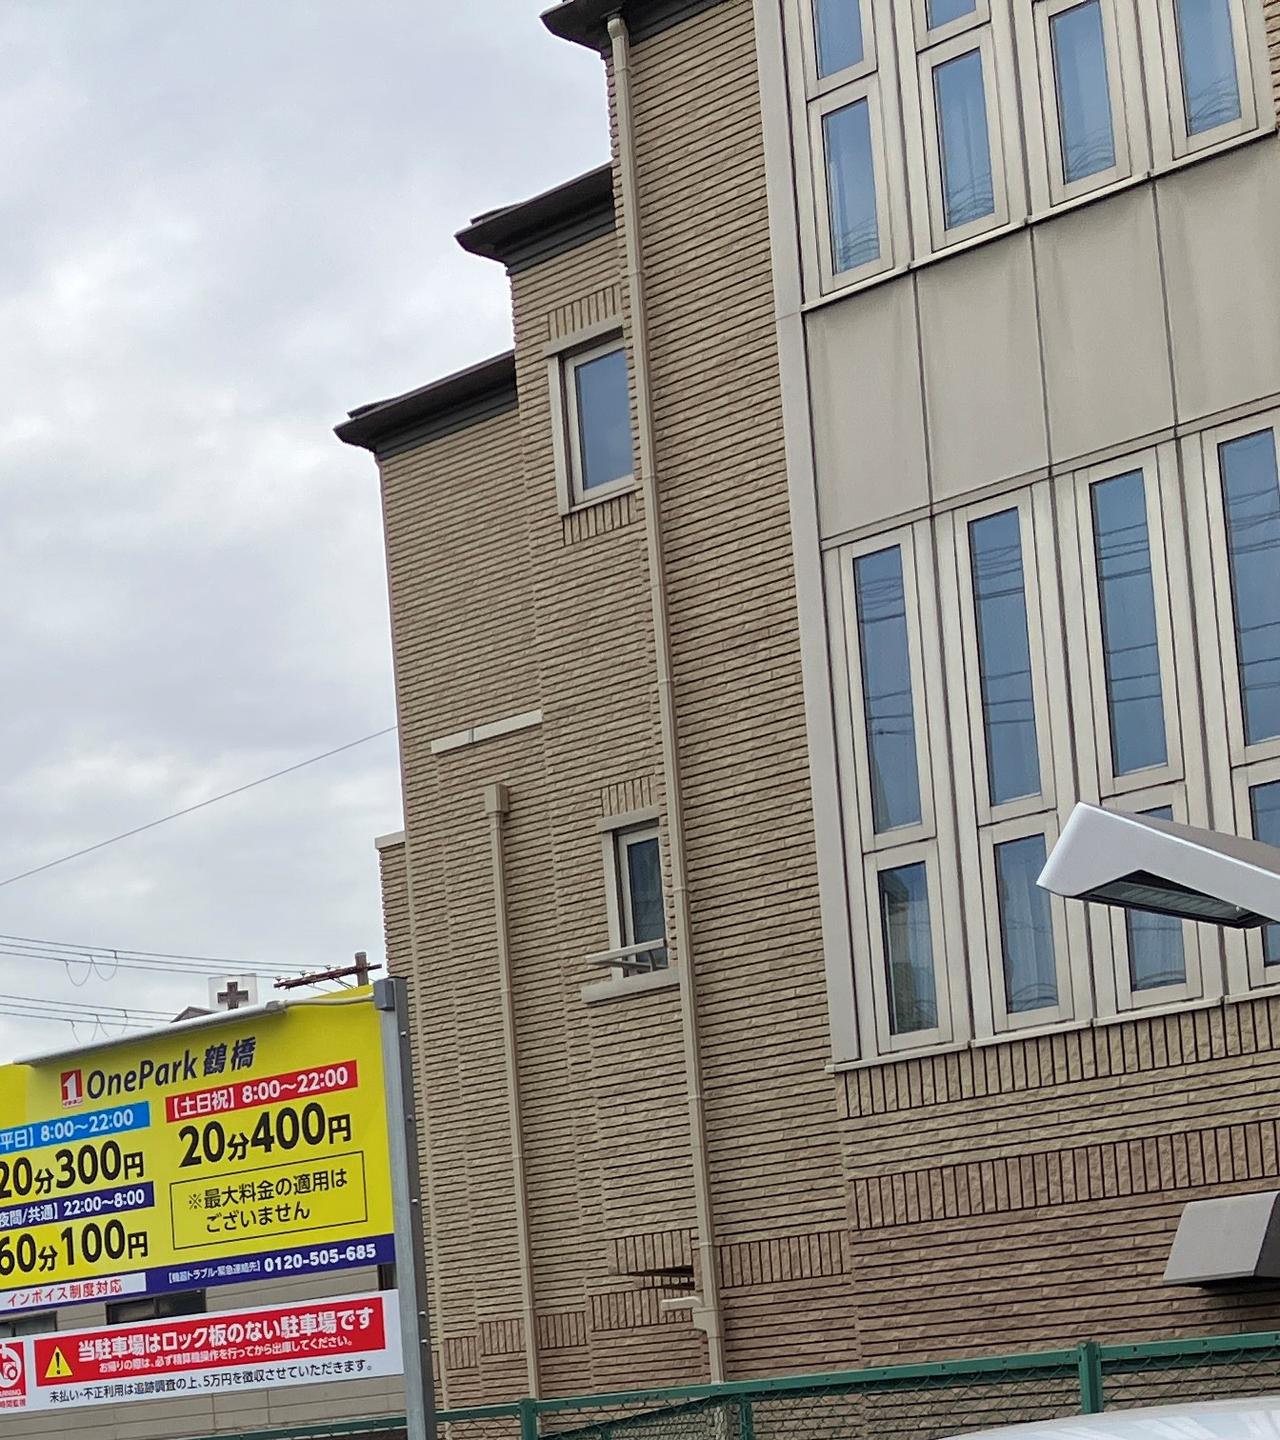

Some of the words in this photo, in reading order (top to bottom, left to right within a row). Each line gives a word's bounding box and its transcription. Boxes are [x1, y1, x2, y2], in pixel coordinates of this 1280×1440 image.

[87, 1050, 197, 1099] OnePark
[203, 1036, 256, 1077] 鶴橋
[178, 1102, 351, 1168] 20分400円
[206, 1201, 310, 1232] ございません
[264, 1243, 376, 1272] 0120-505-685
[8, 1279, 122, 1307] インボイス制度対応
[78, 1306, 373, 1362] 当駐車場はロック板のない駐車場です
